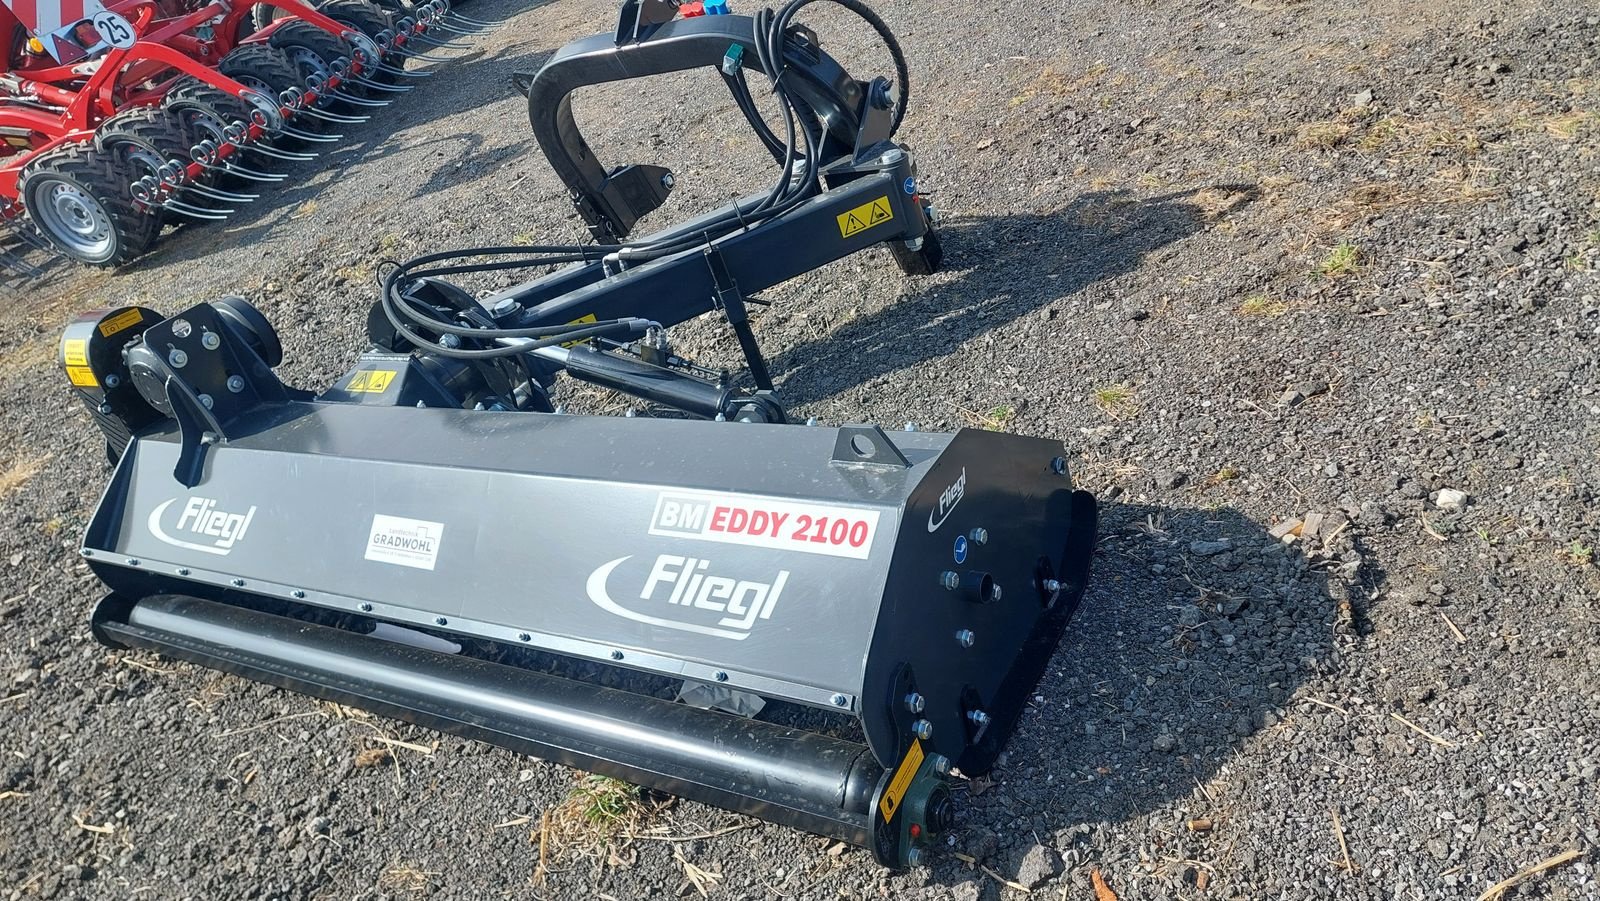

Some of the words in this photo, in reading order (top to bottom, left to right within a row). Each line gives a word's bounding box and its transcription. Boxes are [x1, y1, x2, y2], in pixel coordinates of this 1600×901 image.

[98, 16, 130, 44] 25
[939, 466, 966, 515] Fliegl
[176, 496, 257, 549] Fliegl
[373, 533, 432, 553] GRADWOHL
[659, 501, 706, 530] BM
[709, 506, 789, 538] EDDY
[791, 514, 869, 548] 2100
[639, 554, 791, 630] Fliegl
